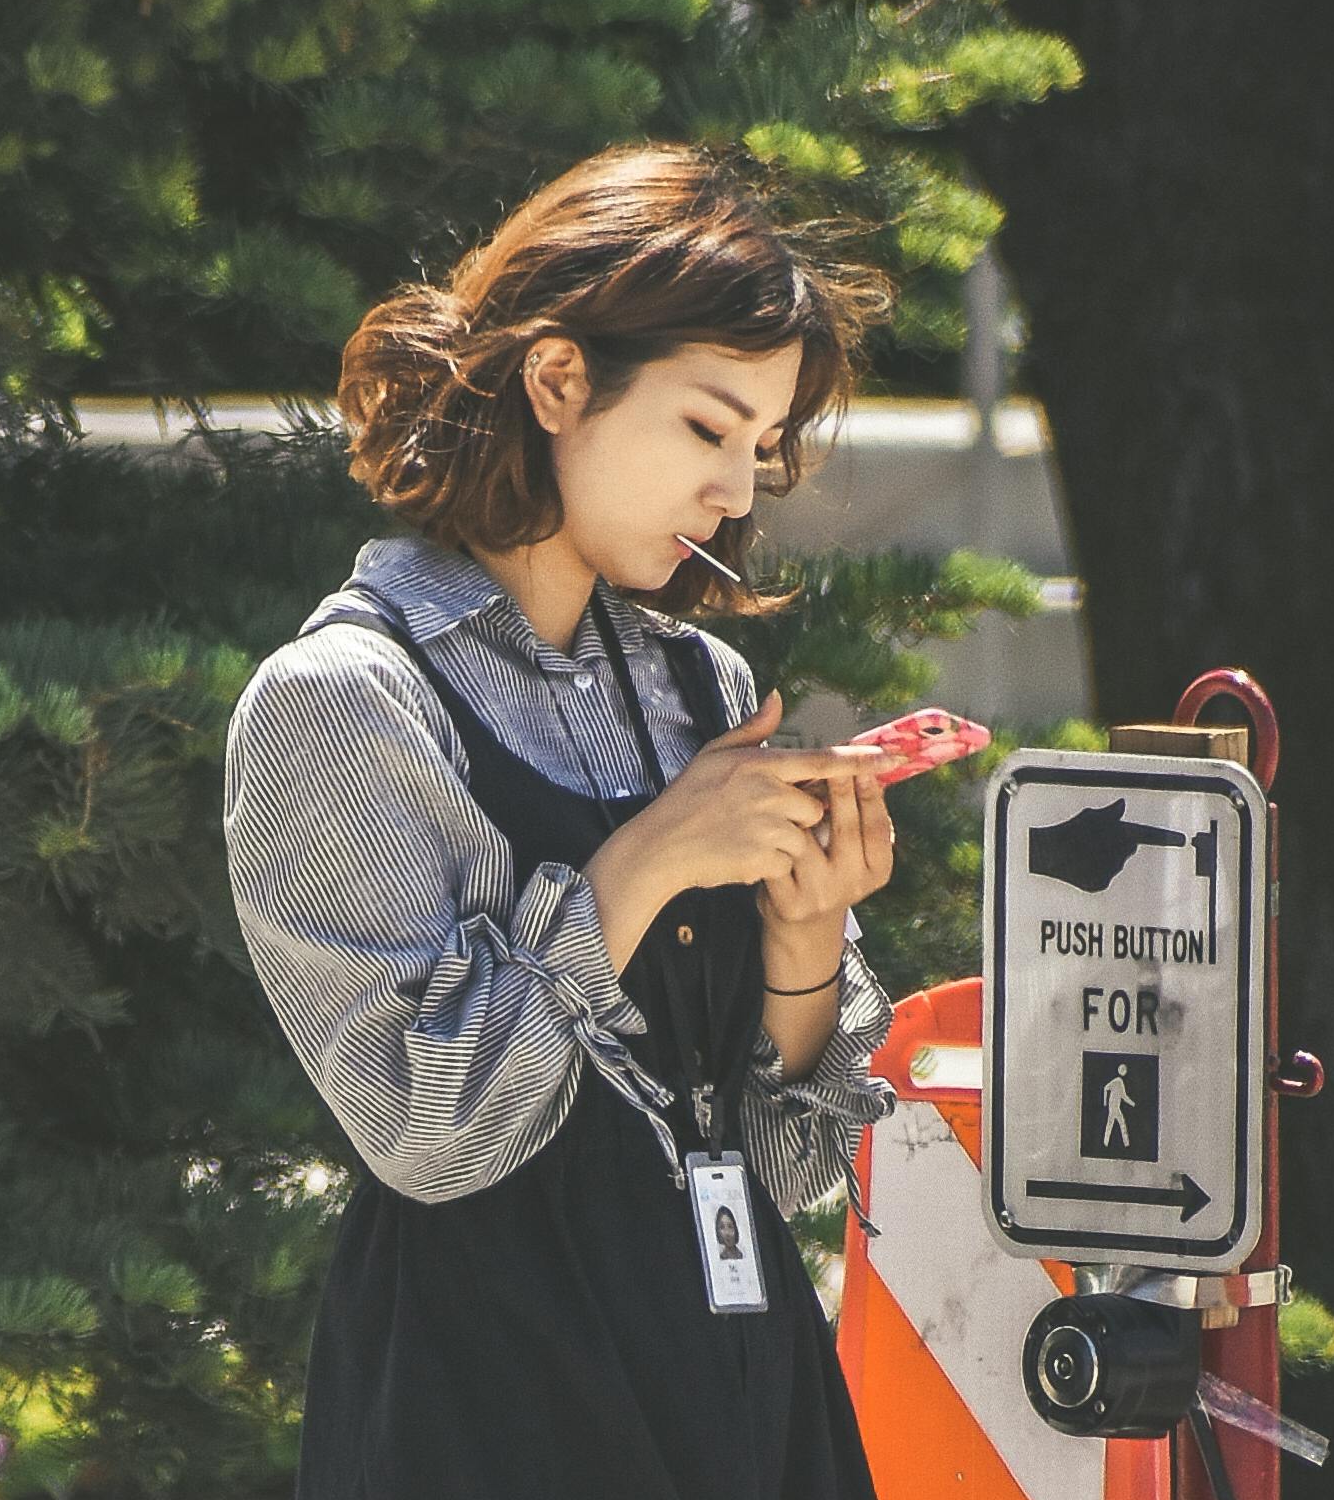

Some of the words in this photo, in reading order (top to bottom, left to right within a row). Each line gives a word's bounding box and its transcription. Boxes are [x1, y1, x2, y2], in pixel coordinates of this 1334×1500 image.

[1040, 919, 1103, 958] PUSH
[1113, 924, 1204, 964] BUTTON
[1082, 986, 1160, 1036] FOR
